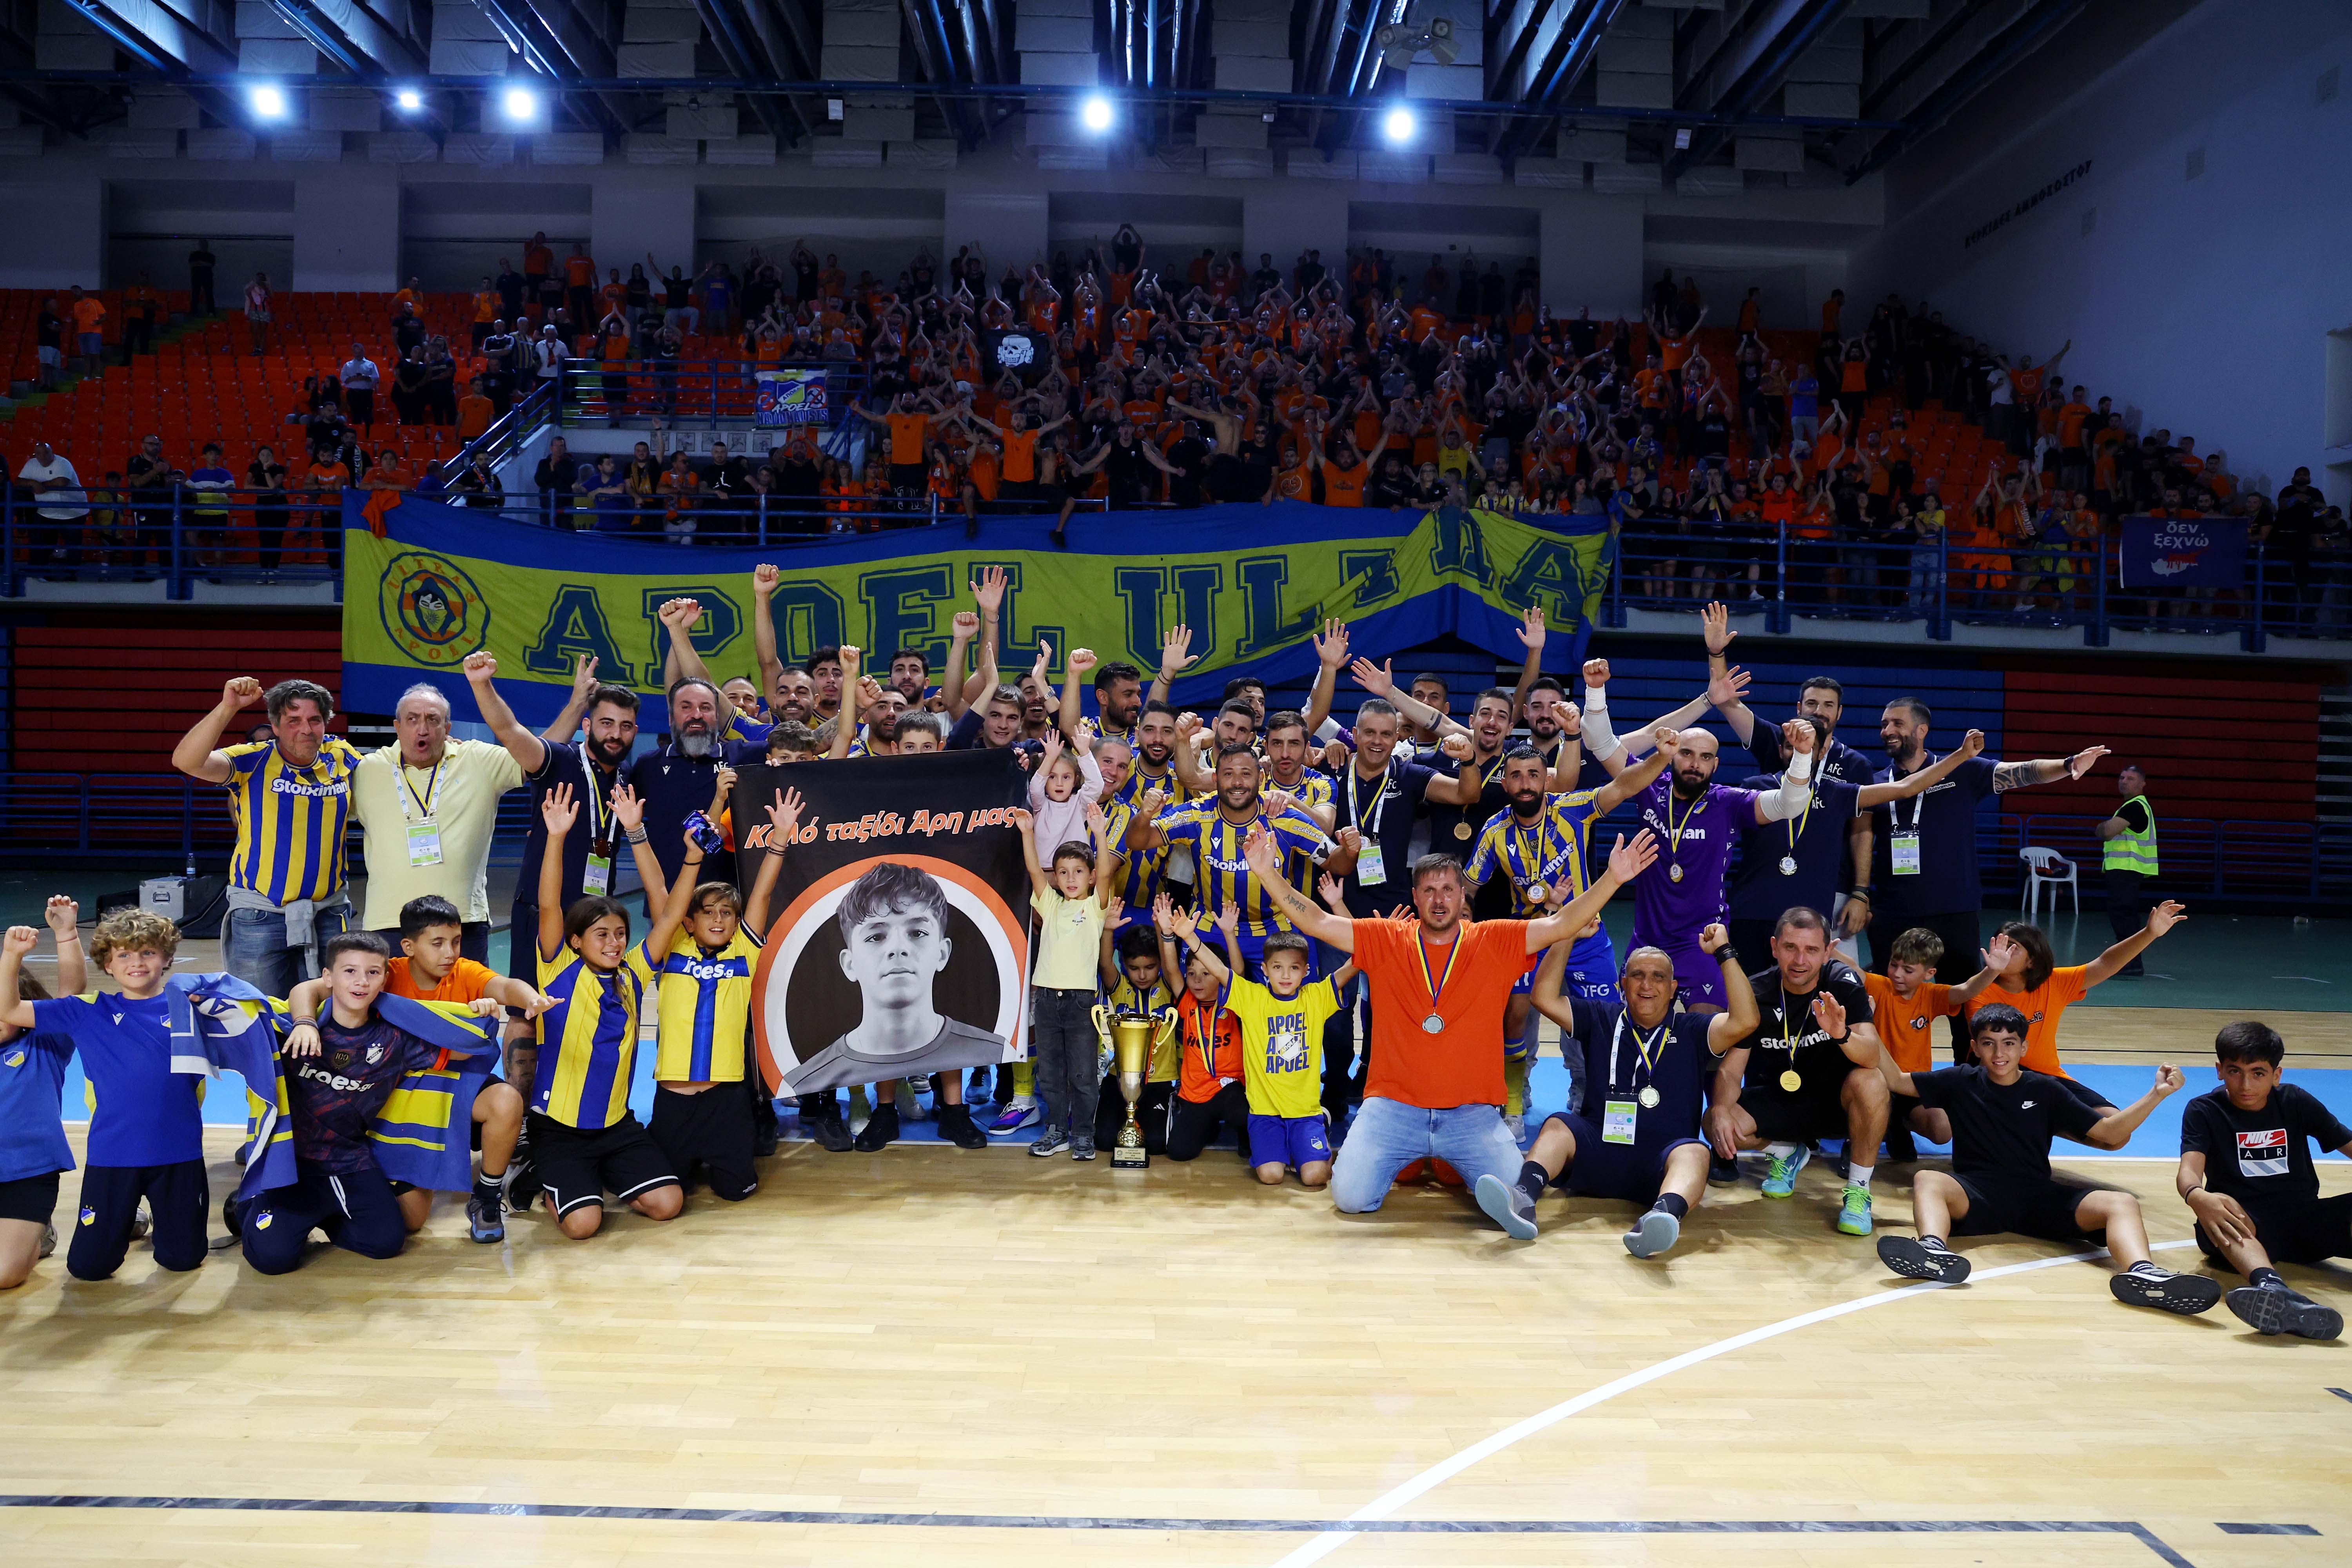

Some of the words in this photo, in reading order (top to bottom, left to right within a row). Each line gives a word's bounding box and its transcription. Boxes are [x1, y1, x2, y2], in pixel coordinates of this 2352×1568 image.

[771, 403, 811, 413] APOEL
[2166, 521, 2199, 534] δεν
[2154, 533, 2209, 549] ξεχνώ
[523, 561, 1065, 688] APOEL
[1827, 763, 1843, 775] AFC
[271, 779, 348, 797] Stoiximan
[1926, 782, 1955, 793] Stoiximan
[1812, 797, 1825, 809] AFC
[826, 811, 906, 843] ταξίδι
[907, 809, 964, 837] Άρη
[967, 806, 1017, 833] μας
[1205, 855, 1279, 872] Stoixin
[1513, 842, 1575, 886] Stoximan
[1581, 984, 1610, 997] YFG
[1268, 1012, 1307, 1035] APOEL
[1265, 1051, 1310, 1074] APOEL
[298, 1063, 375, 1093] iroes.gr
[2245, 1131, 2274, 1145] NIKE
[2244, 1148, 2283, 1159] AIR
